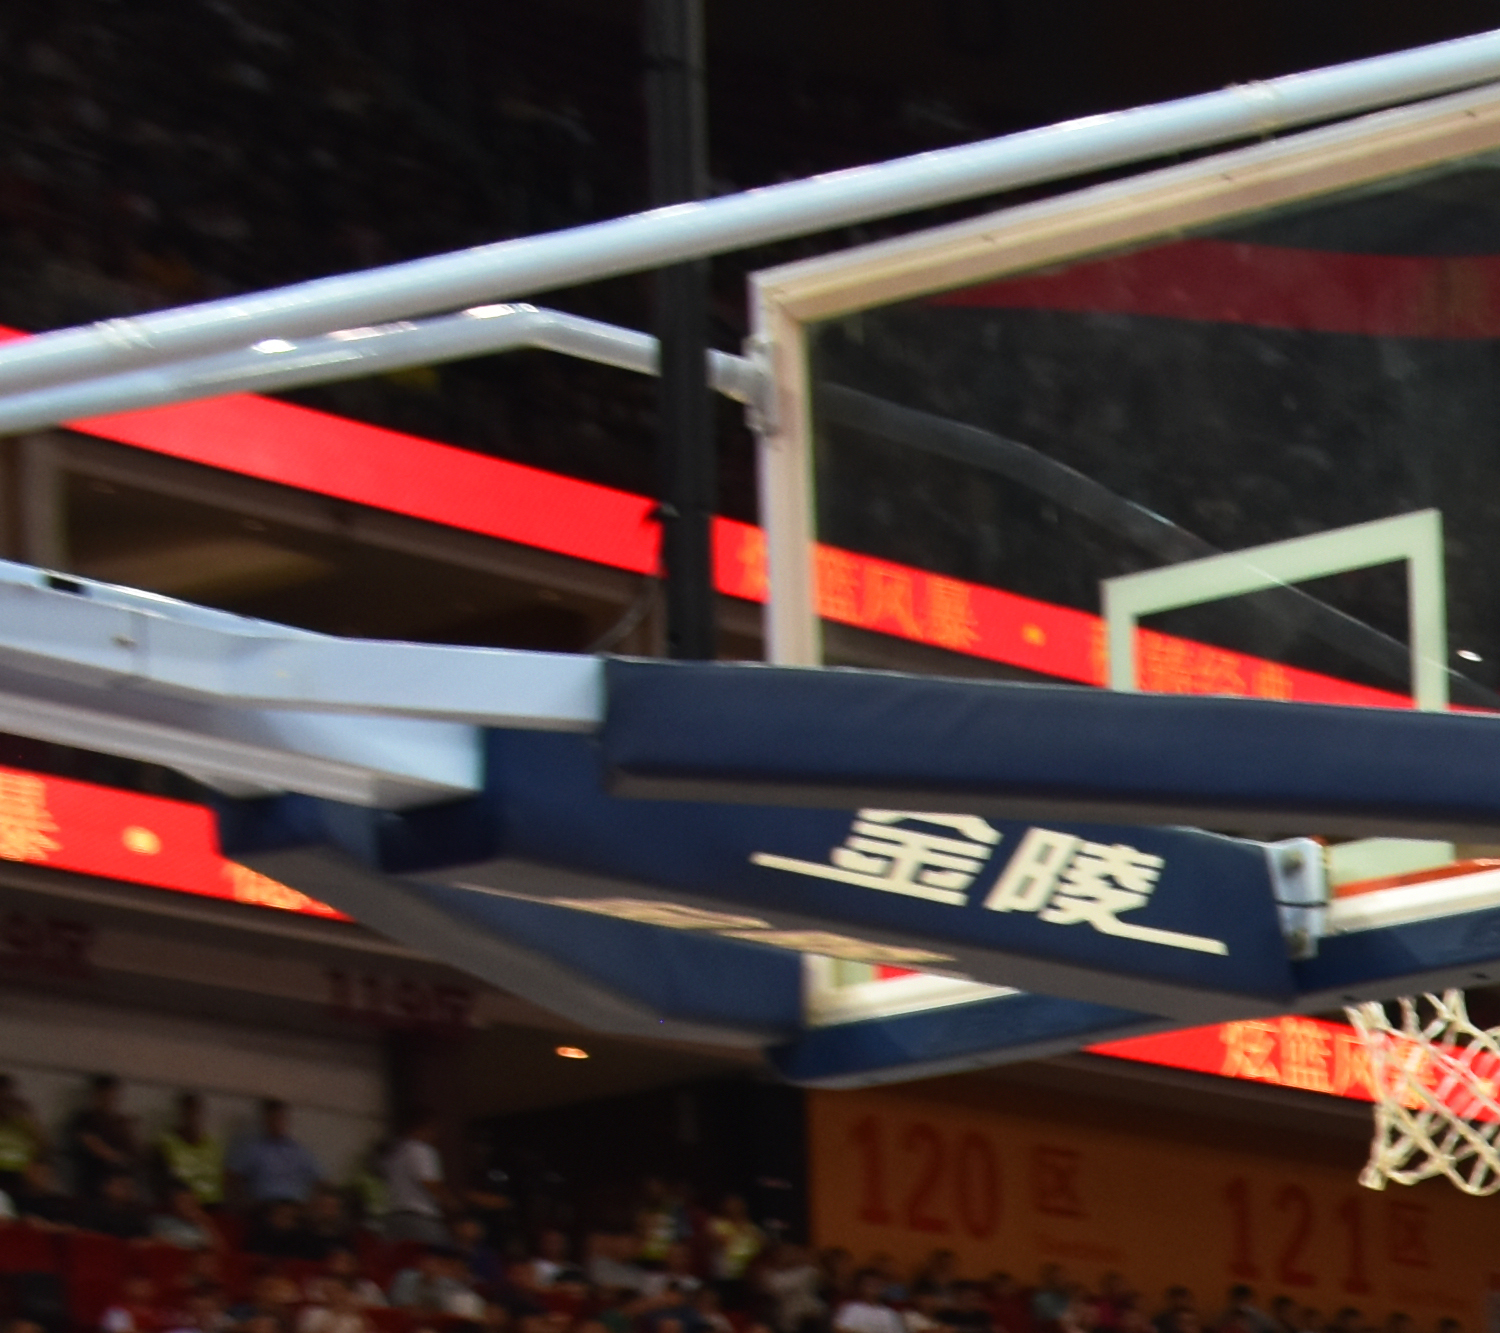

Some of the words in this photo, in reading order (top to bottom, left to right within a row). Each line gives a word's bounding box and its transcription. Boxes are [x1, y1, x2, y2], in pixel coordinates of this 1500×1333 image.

[749, 808, 1229, 956] 金陵
[850, 1115, 998, 1239] 120
[1222, 1176, 1374, 1295] 121
